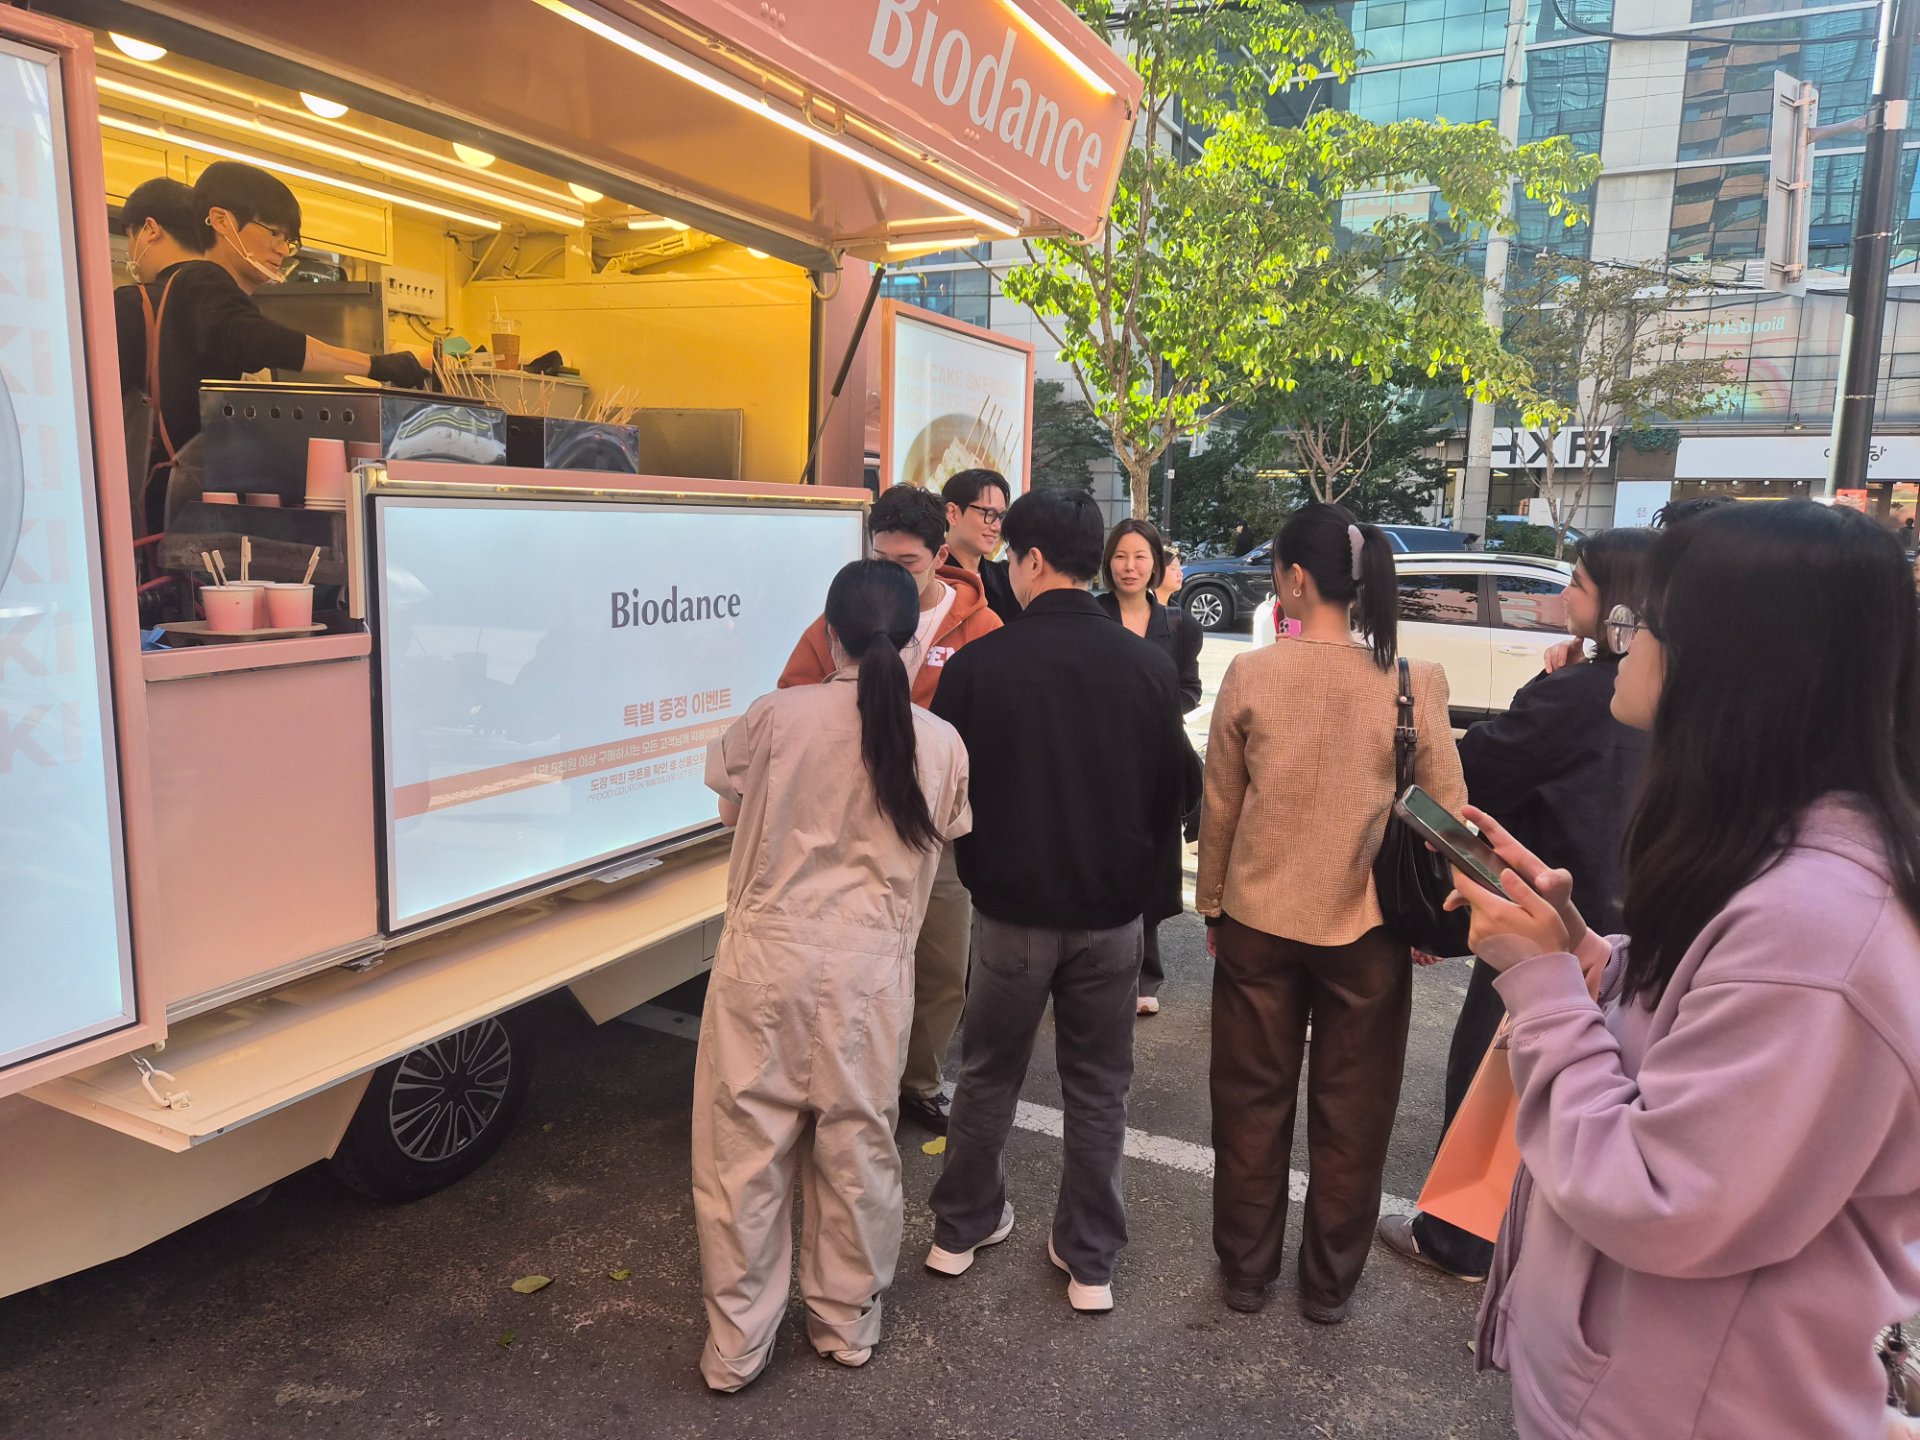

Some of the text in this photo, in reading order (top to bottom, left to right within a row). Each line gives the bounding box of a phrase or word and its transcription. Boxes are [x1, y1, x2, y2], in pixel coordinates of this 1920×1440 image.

[868, 0, 1102, 194] Biodance
[610, 585, 742, 629] Biodance
[624, 688, 731, 727] 특별 증정 이벤트
[0, 701, 83, 767] KI
[551, 756, 577, 776] 5천원
[578, 751, 597, 769] 이상
[599, 744, 641, 764] 구매하시는
[642, 739, 659, 754] 모든
[591, 777, 608, 791] 도장
[627, 765, 653, 782] 쿠폰을
[653, 761, 668, 775] 확인
[614, 782, 644, 796] COUPON
